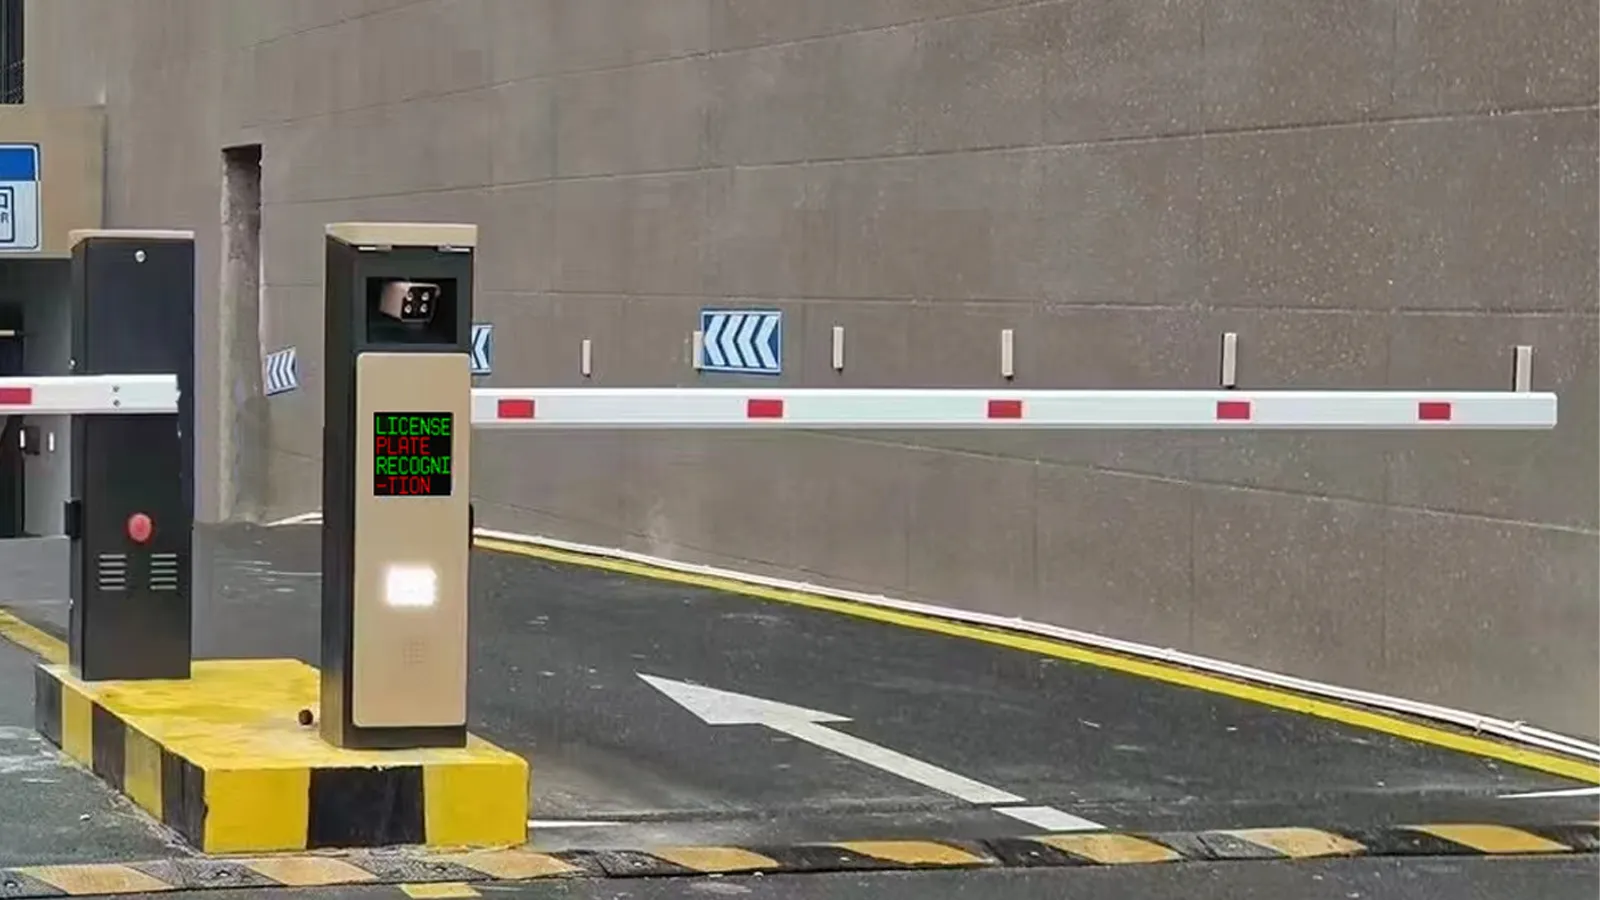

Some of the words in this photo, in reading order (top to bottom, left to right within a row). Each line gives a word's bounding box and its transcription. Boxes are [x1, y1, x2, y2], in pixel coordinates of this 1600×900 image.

[376, 416, 451, 436] LICENSE
[376, 436, 431, 455] PLATE
[376, 456, 451, 475] RECOGNI
[376, 476, 431, 495] -TION
